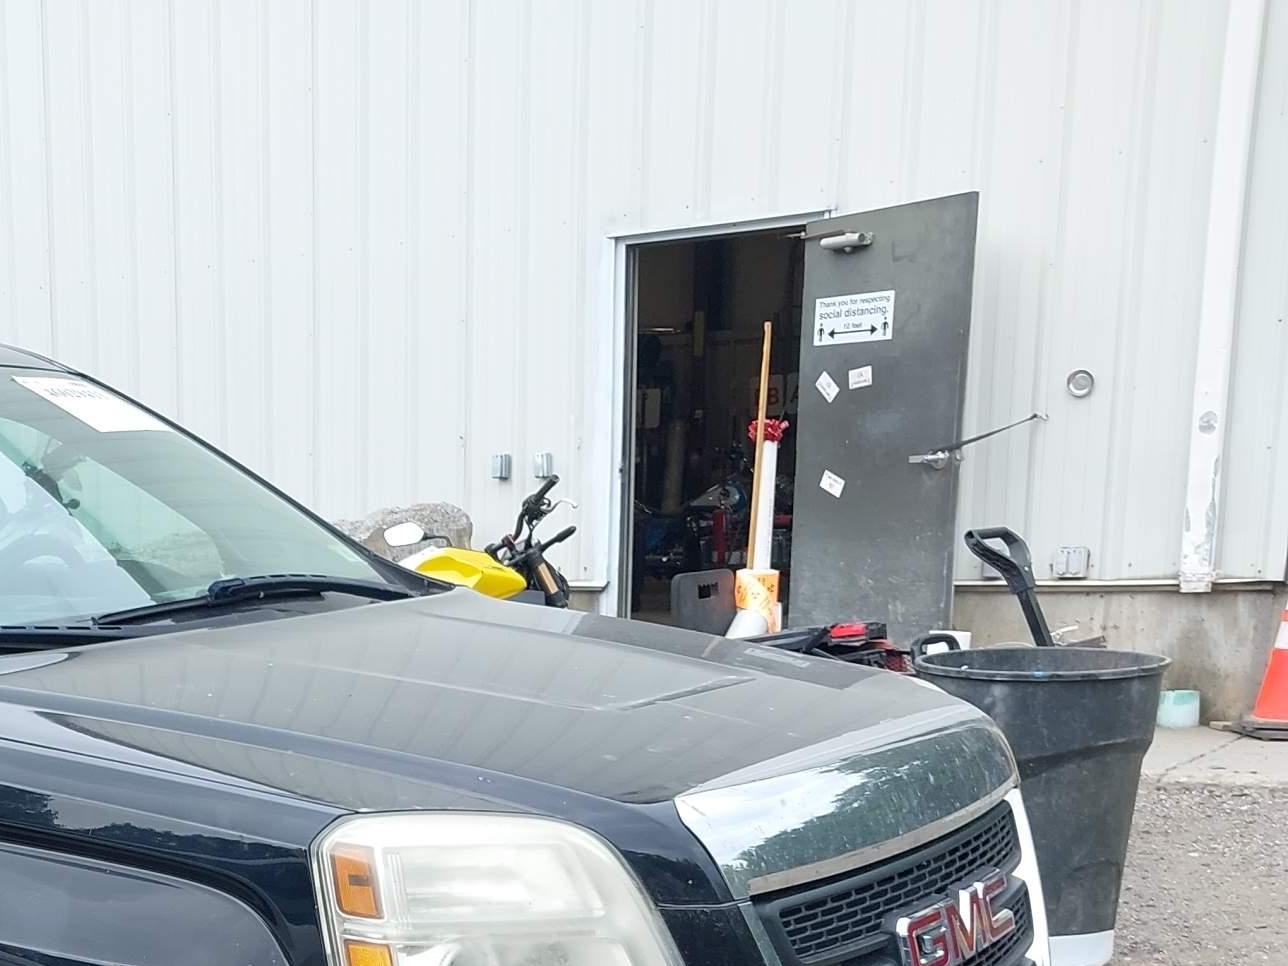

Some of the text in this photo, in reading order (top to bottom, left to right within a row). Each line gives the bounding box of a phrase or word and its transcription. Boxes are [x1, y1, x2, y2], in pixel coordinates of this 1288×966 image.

[819, 301, 836, 309] Thank
[859, 295, 891, 304] respecting
[819, 305, 889, 320] social distancing.
